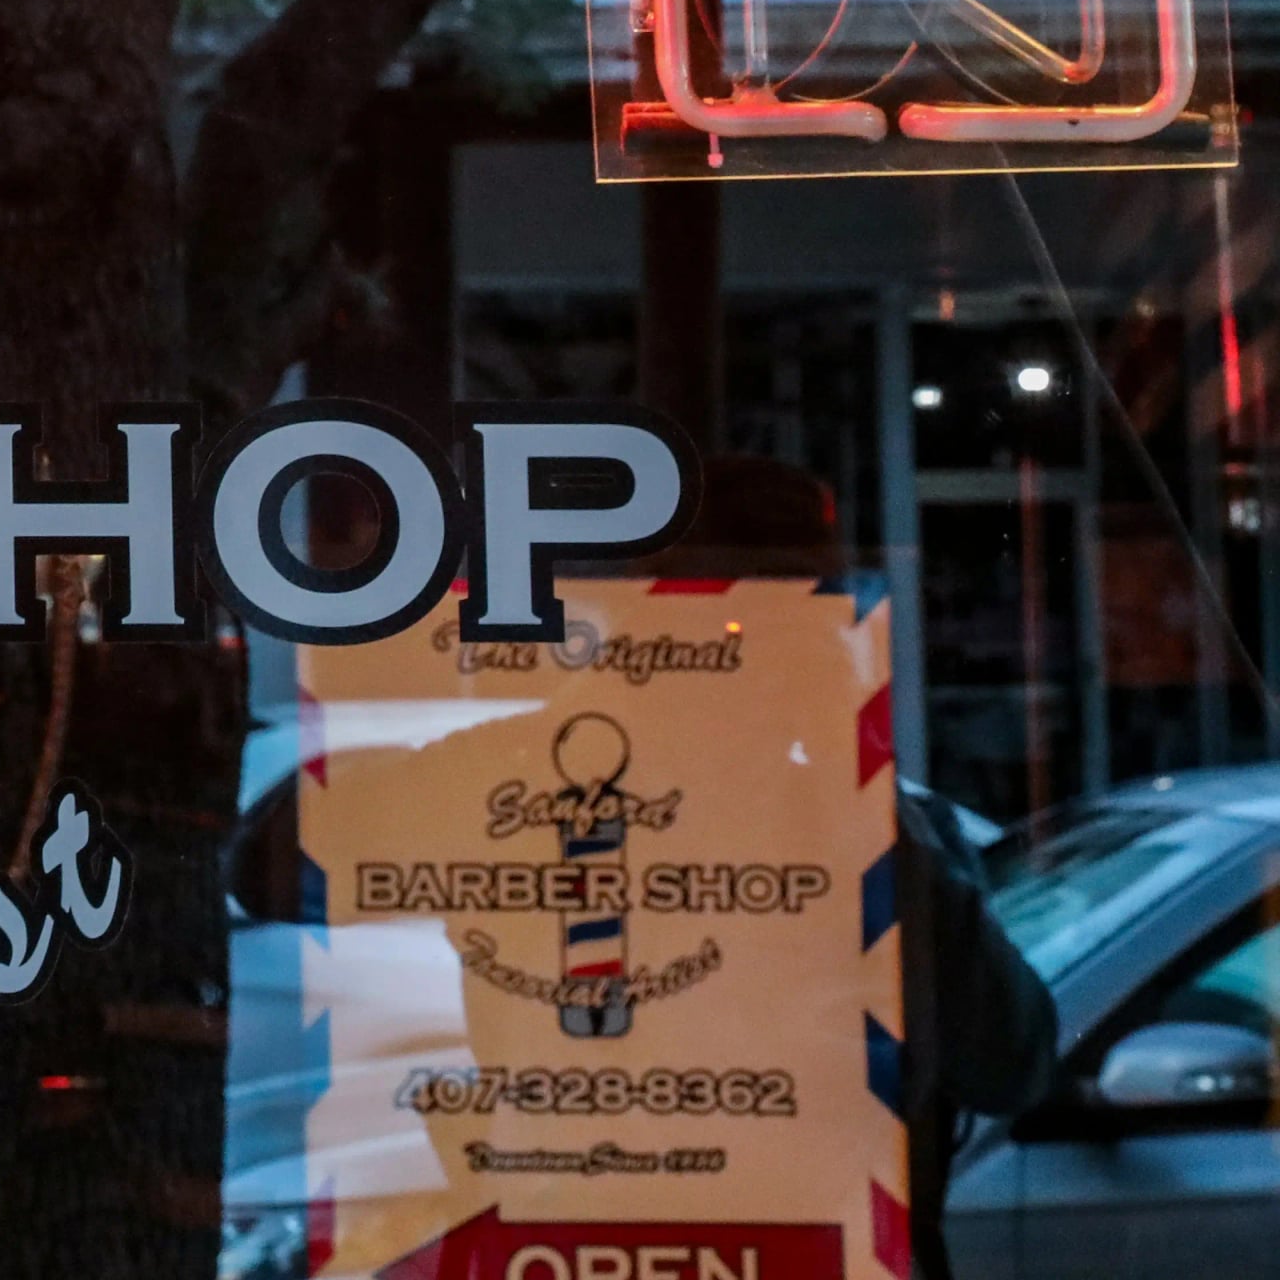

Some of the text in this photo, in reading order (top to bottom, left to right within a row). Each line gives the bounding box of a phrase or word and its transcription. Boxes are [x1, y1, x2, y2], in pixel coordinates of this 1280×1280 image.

[550, 620, 743, 685] Original
[487, 778, 682, 839] Sanford
[357, 862, 831, 913] BARBER SHOP
[395, 1067, 797, 1117] 407-328-8362
